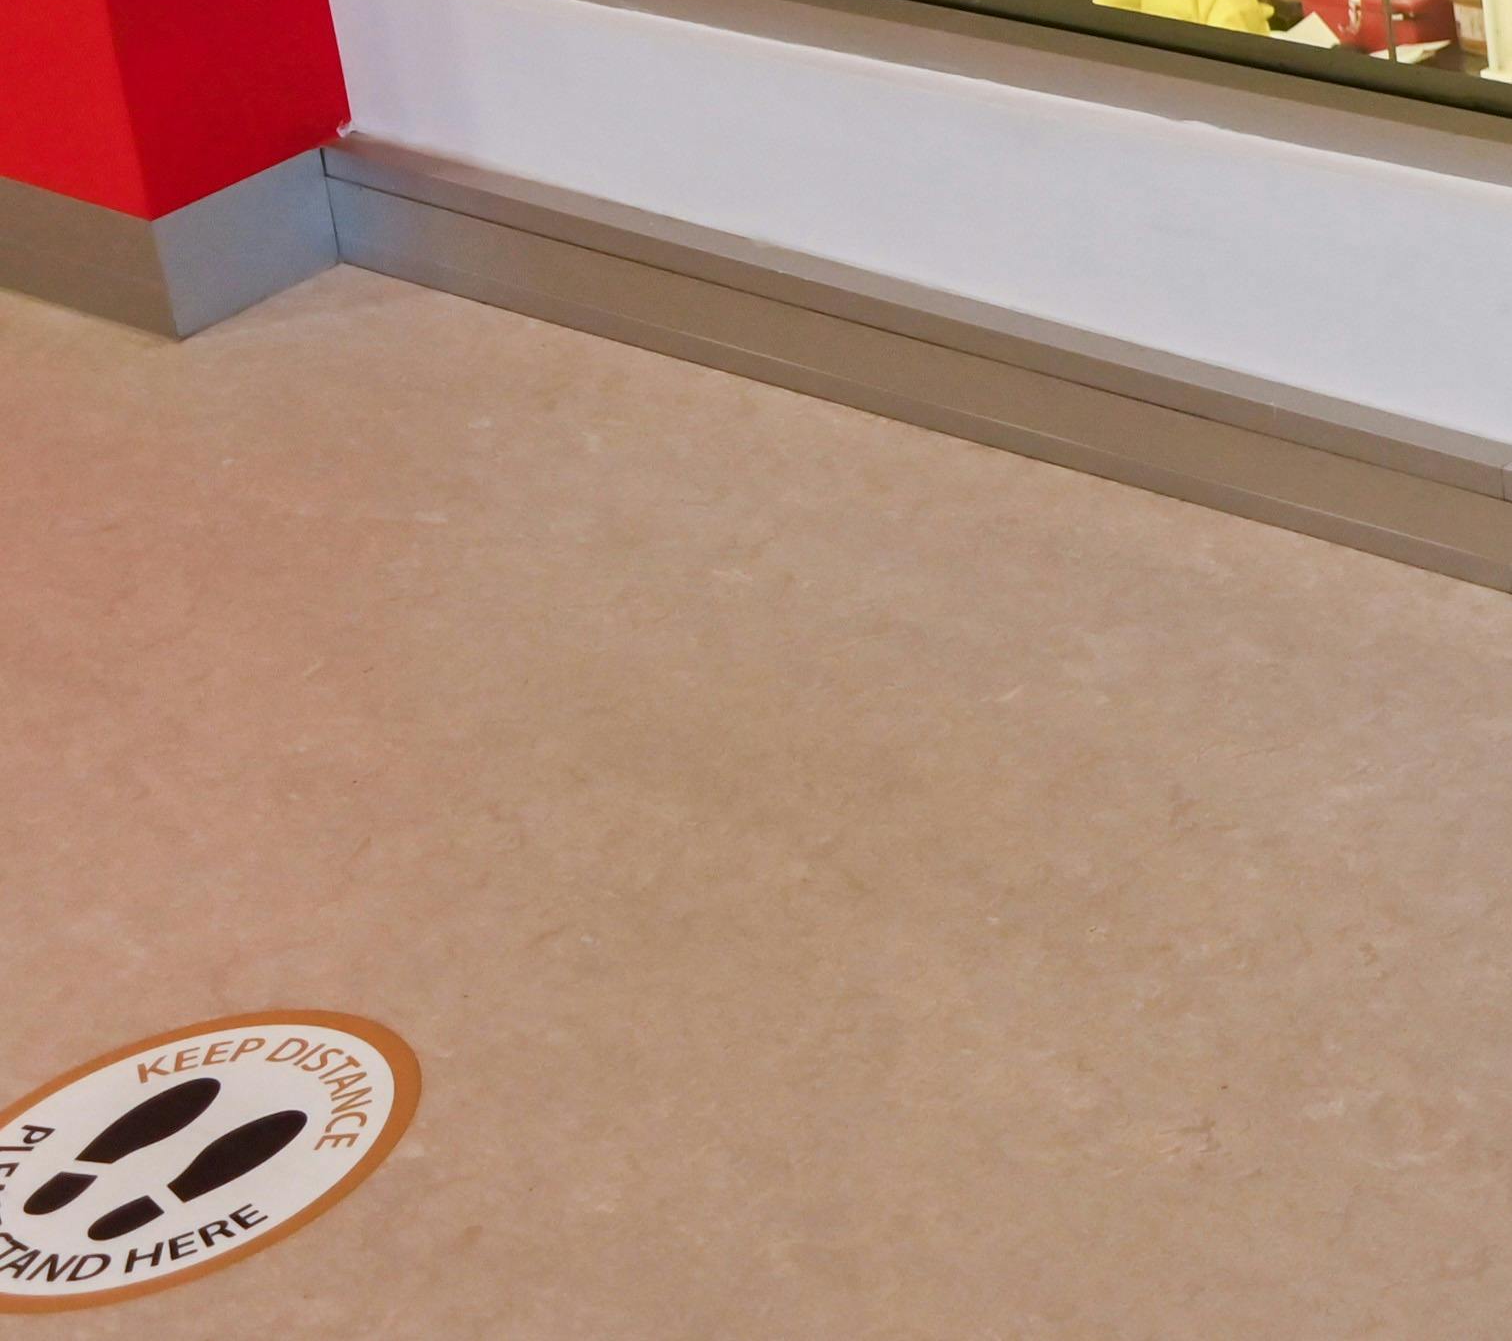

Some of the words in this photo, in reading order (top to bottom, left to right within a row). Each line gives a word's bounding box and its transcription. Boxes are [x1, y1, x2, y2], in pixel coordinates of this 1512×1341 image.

[137, 1037, 266, 1085] KEEP
[265, 1037, 373, 1151] DISTANCE
[124, 1203, 269, 1274] HERE
